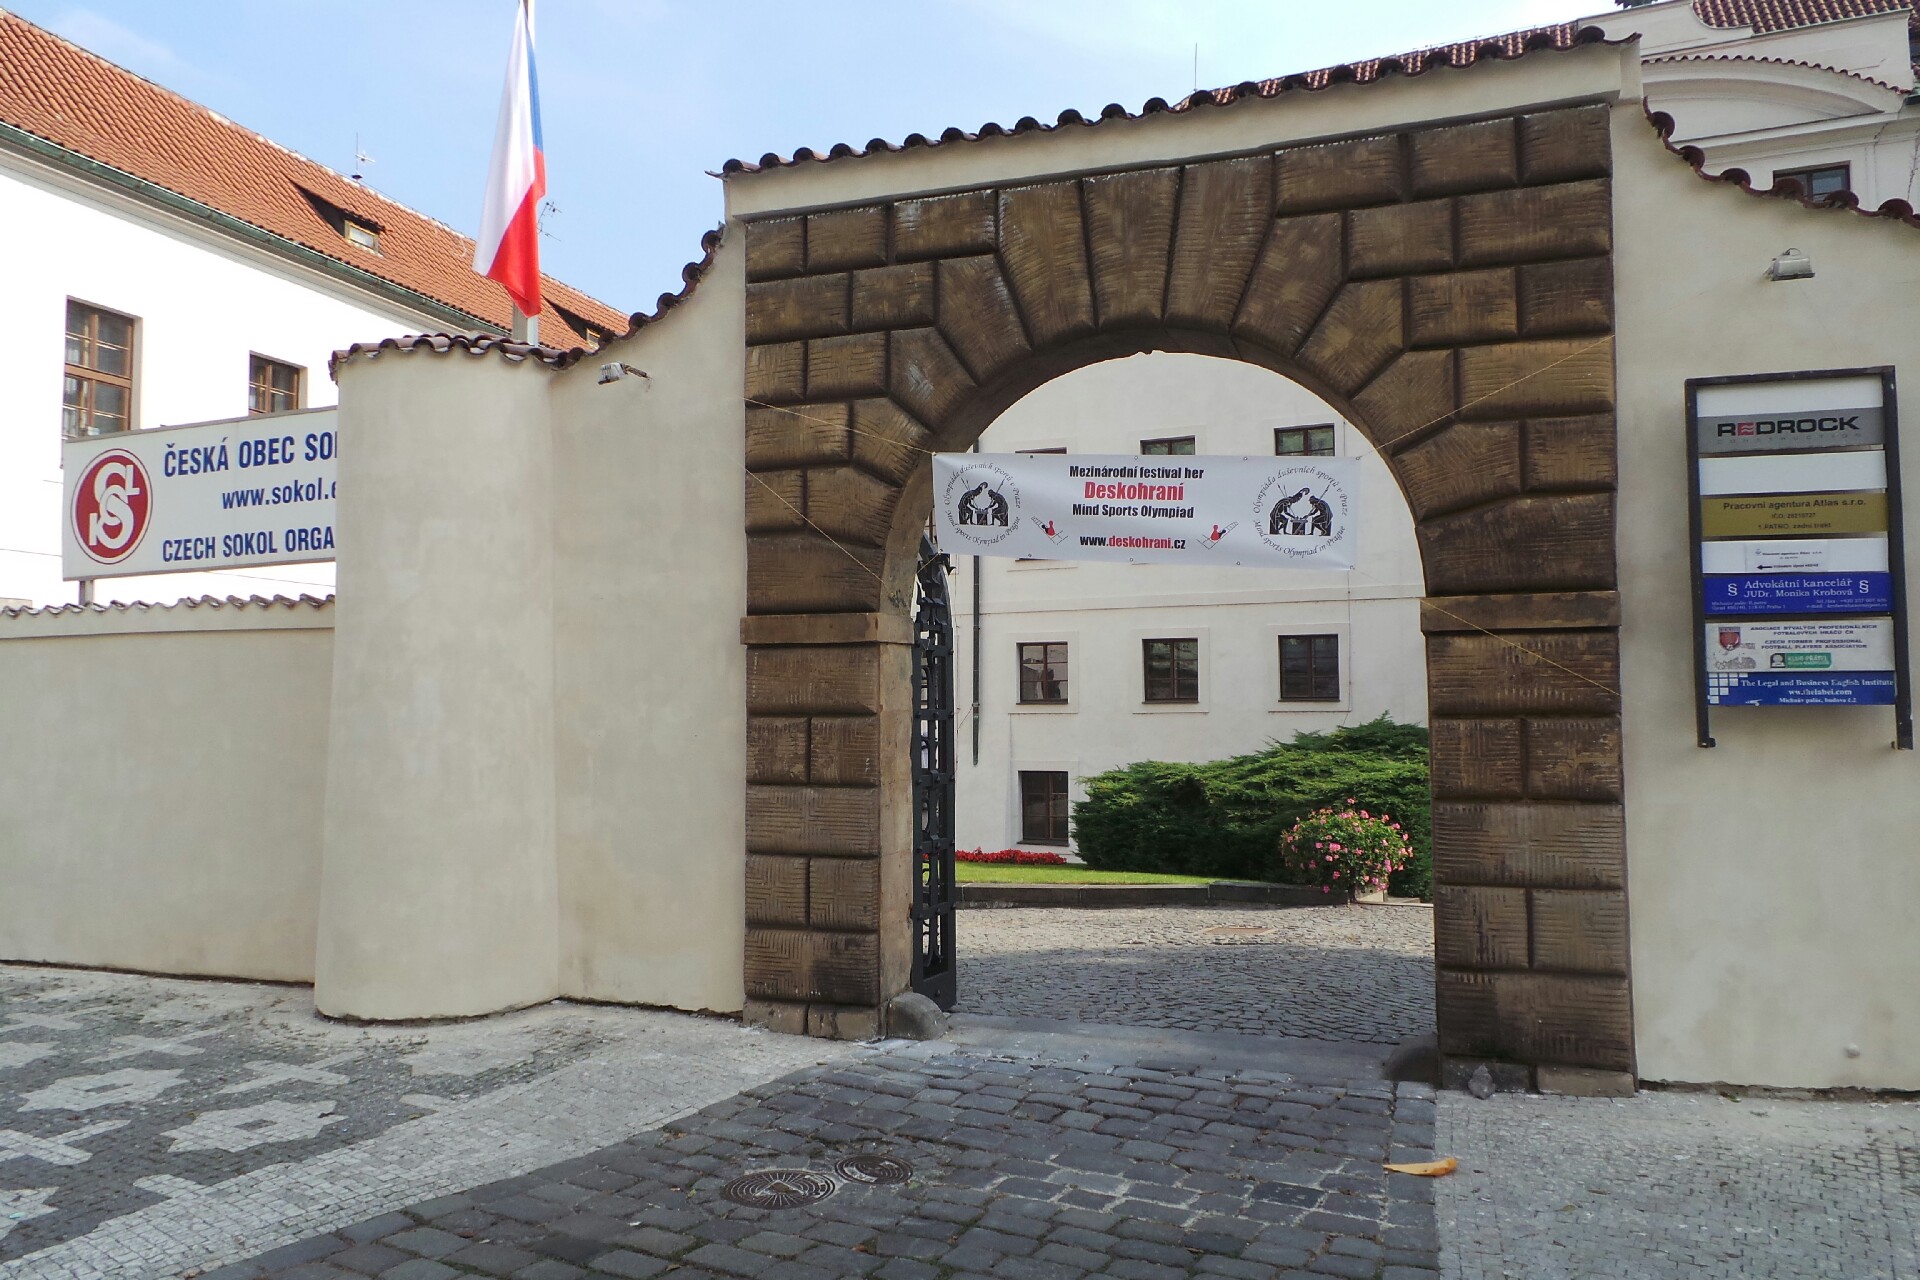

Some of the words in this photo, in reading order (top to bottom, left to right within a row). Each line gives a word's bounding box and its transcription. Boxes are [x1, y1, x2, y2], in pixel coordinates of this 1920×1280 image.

[1718, 416, 1860, 436] REDROCK
[164, 437, 228, 477] ČESKÁ
[238, 436, 294, 468] OBEC
[305, 431, 337, 462] SO
[1070, 465, 1137, 478] Mezinárodní
[1140, 466, 1181, 478] festival
[1185, 467, 1204, 480] her
[1084, 482, 1184, 500] Deskohraní
[1072, 504, 1099, 516] Mind
[1102, 504, 1138, 518] Sports
[1141, 505, 1194, 518] Olympiad
[1769, 501, 1810, 510] agentura
[1080, 536, 1186, 549] www.deskohrani.cz
[1326, 526, 1346, 547] Prague
[163, 536, 216, 562] CZECH
[223, 532, 278, 558] SOKOL
[285, 526, 335, 553] ORGA
[1804, 578, 1852, 588] kancelář
[1776, 589, 1810, 598] Monika
[1832, 680, 1860, 688] English
